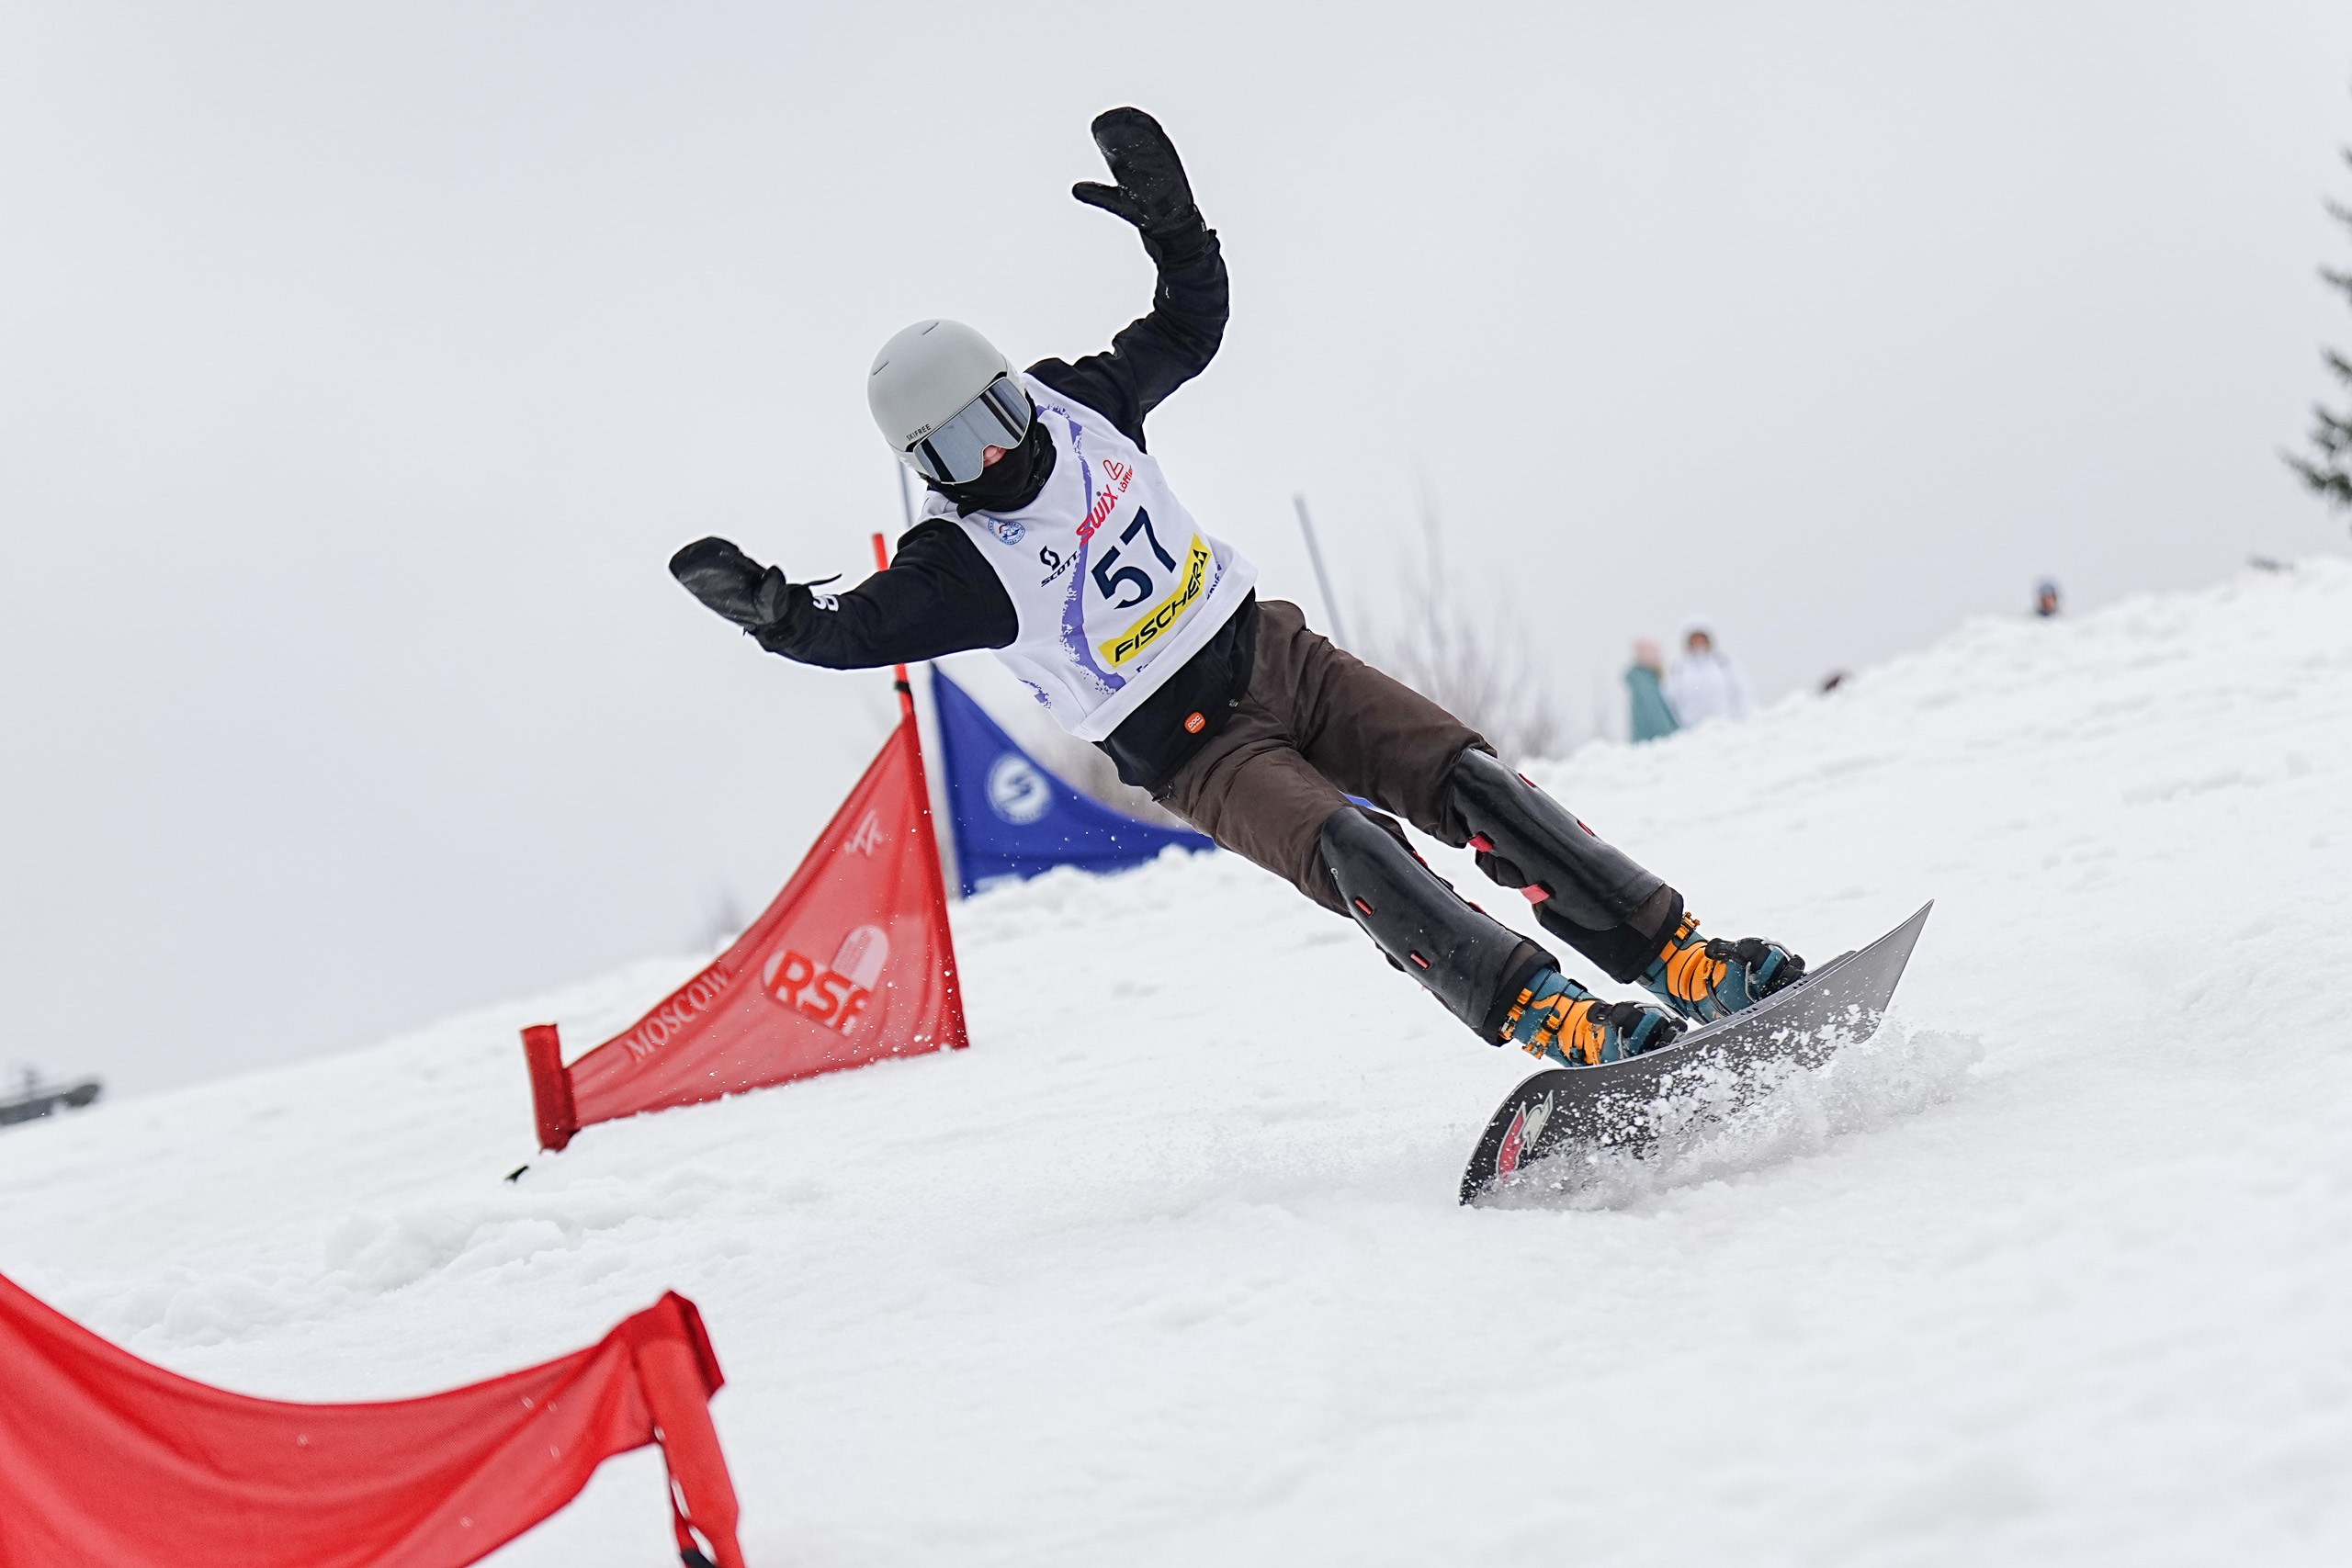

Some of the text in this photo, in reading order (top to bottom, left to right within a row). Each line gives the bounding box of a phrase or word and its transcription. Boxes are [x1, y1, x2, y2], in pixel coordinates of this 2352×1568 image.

[906, 423, 932, 441] SKIFREE
[1041, 551, 1078, 587] SCOTT
[1091, 505, 1177, 609] 57
[1114, 562, 1202, 662] FISCHER
[627, 964, 732, 1064] MOSCOW
